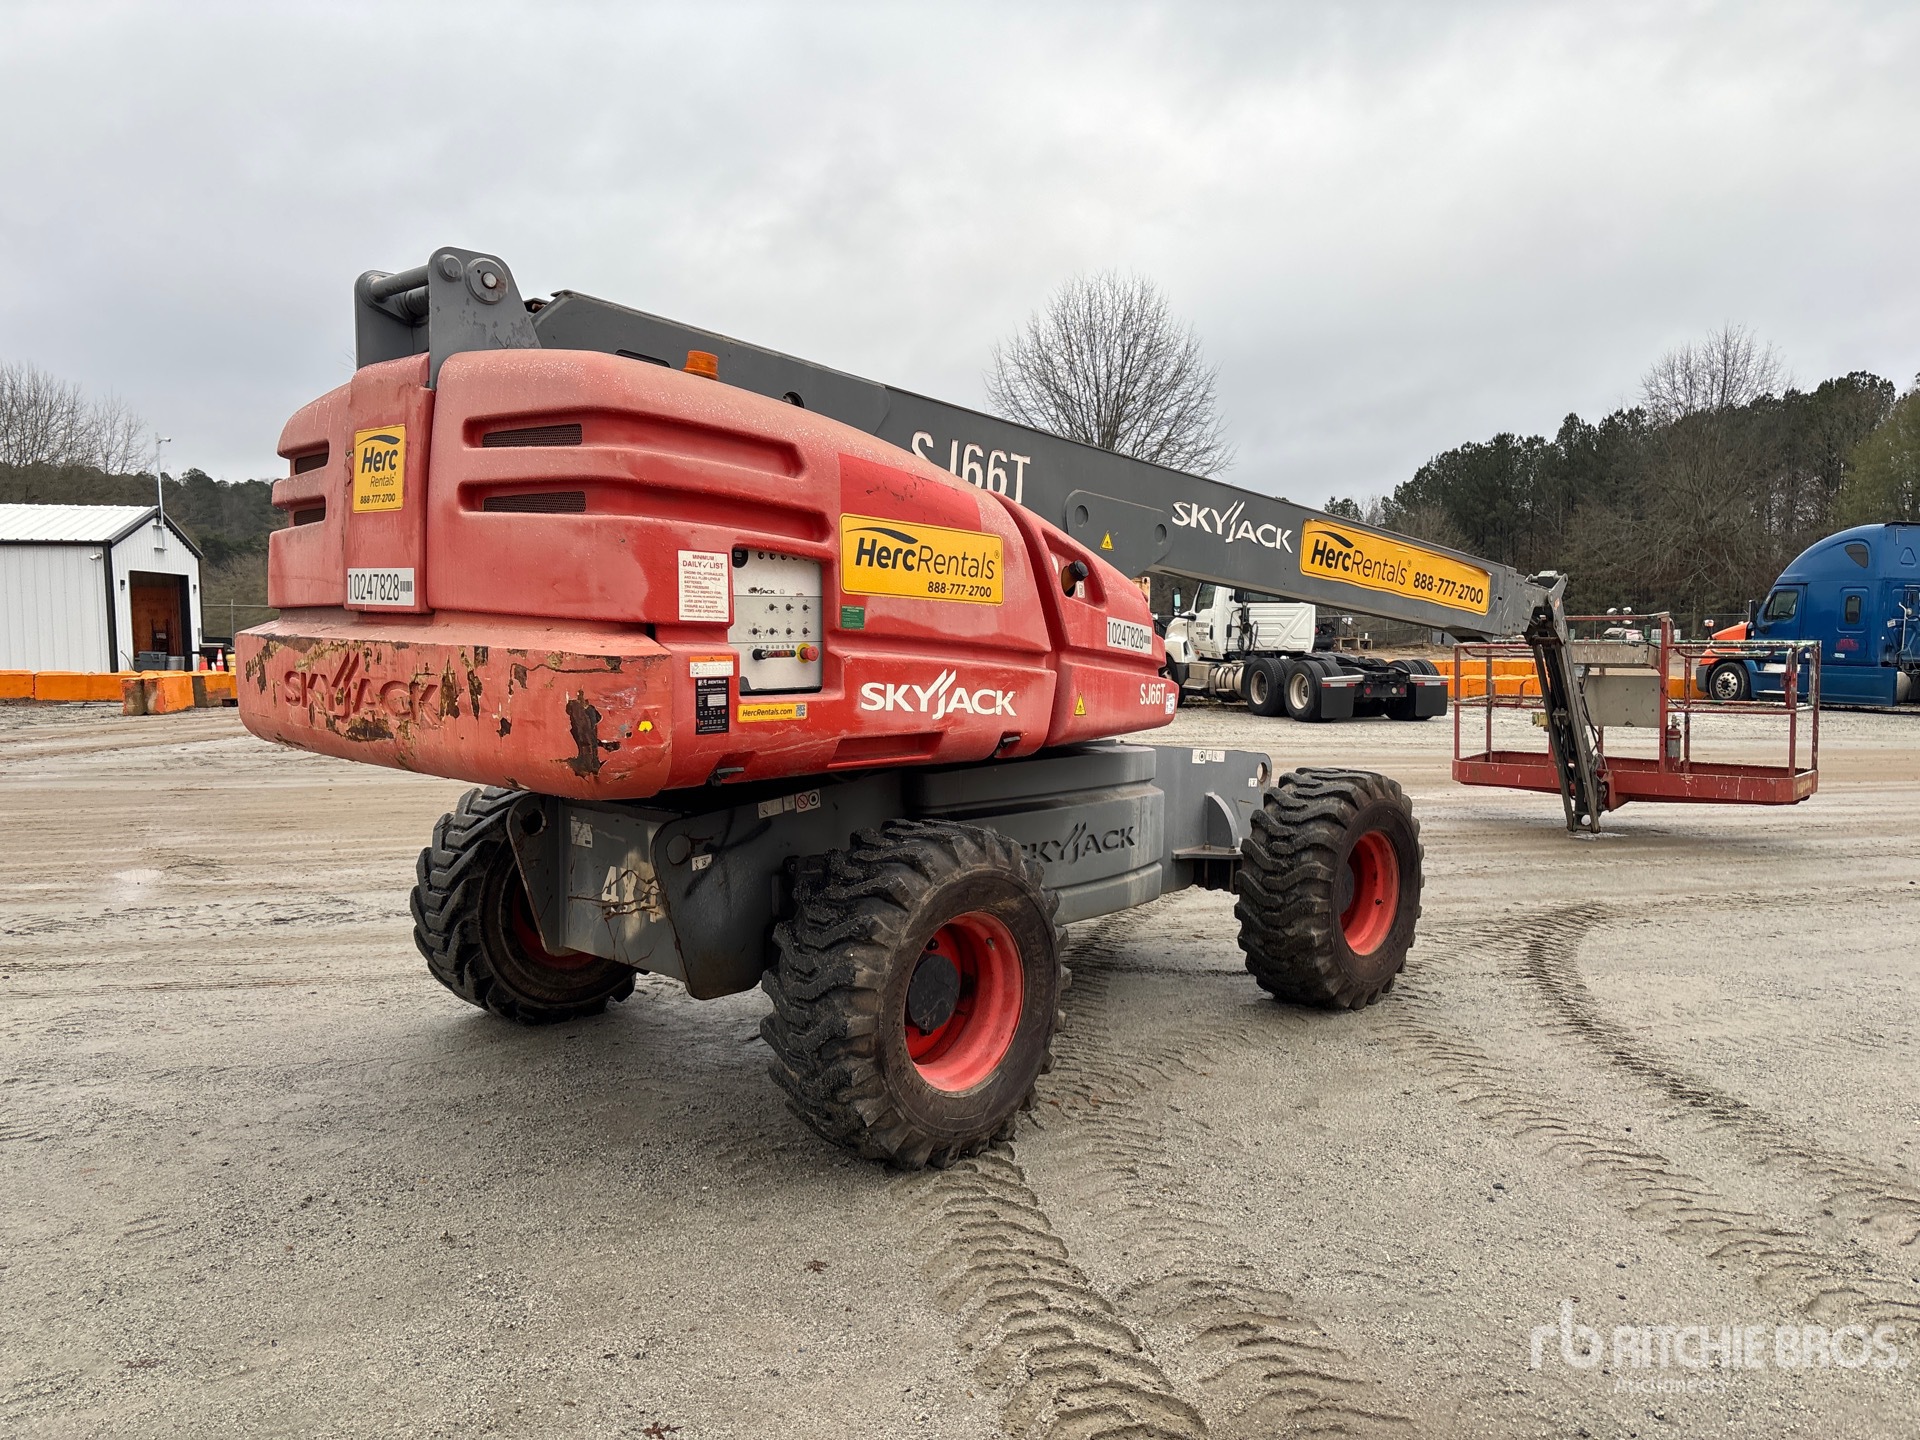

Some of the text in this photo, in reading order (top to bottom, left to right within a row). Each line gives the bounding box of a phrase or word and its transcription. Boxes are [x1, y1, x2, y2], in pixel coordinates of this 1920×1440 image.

[361, 446, 398, 474] Herc
[369, 475, 395, 488] Rentals
[359, 493, 396, 505] 888-777-2700
[1171, 500, 1293, 554] SKYJACK
[682, 560, 724, 570] DAILY LIST
[348, 573, 400, 601] 10247828
[927, 581, 992, 598] 888-777-2700
[1413, 571, 1484, 605] 888-777-2700
[1107, 621, 1144, 650] 10247828
[284, 650, 443, 728] SKYJACK
[860, 668, 1017, 720] SKYJACK
[1140, 683, 1166, 705] SJ66T
[742, 708, 793, 717] HercRentals.com
